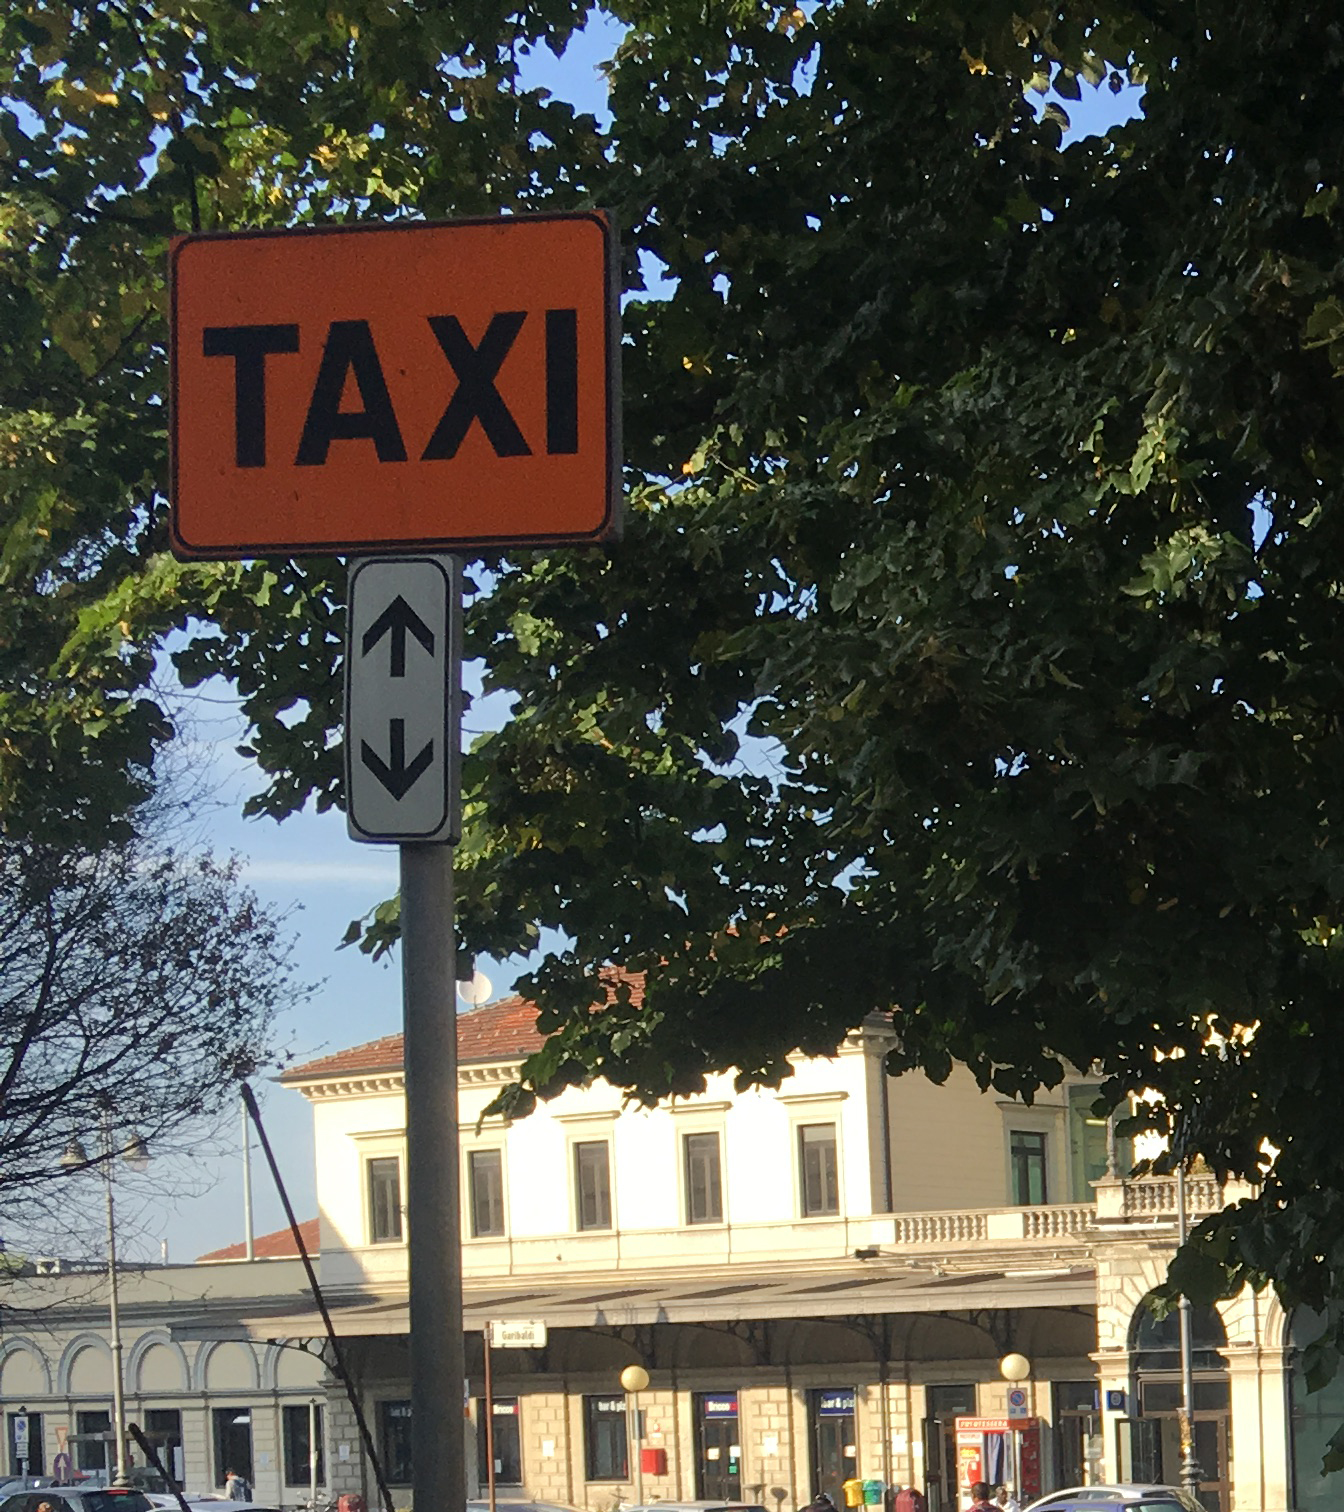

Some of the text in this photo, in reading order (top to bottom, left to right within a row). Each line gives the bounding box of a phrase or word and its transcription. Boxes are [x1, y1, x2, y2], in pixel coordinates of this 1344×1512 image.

[203, 309, 578, 468] TAXI
[501, 1331, 535, 1341] Garibaldi
[708, 1401, 730, 1412] Bricco
